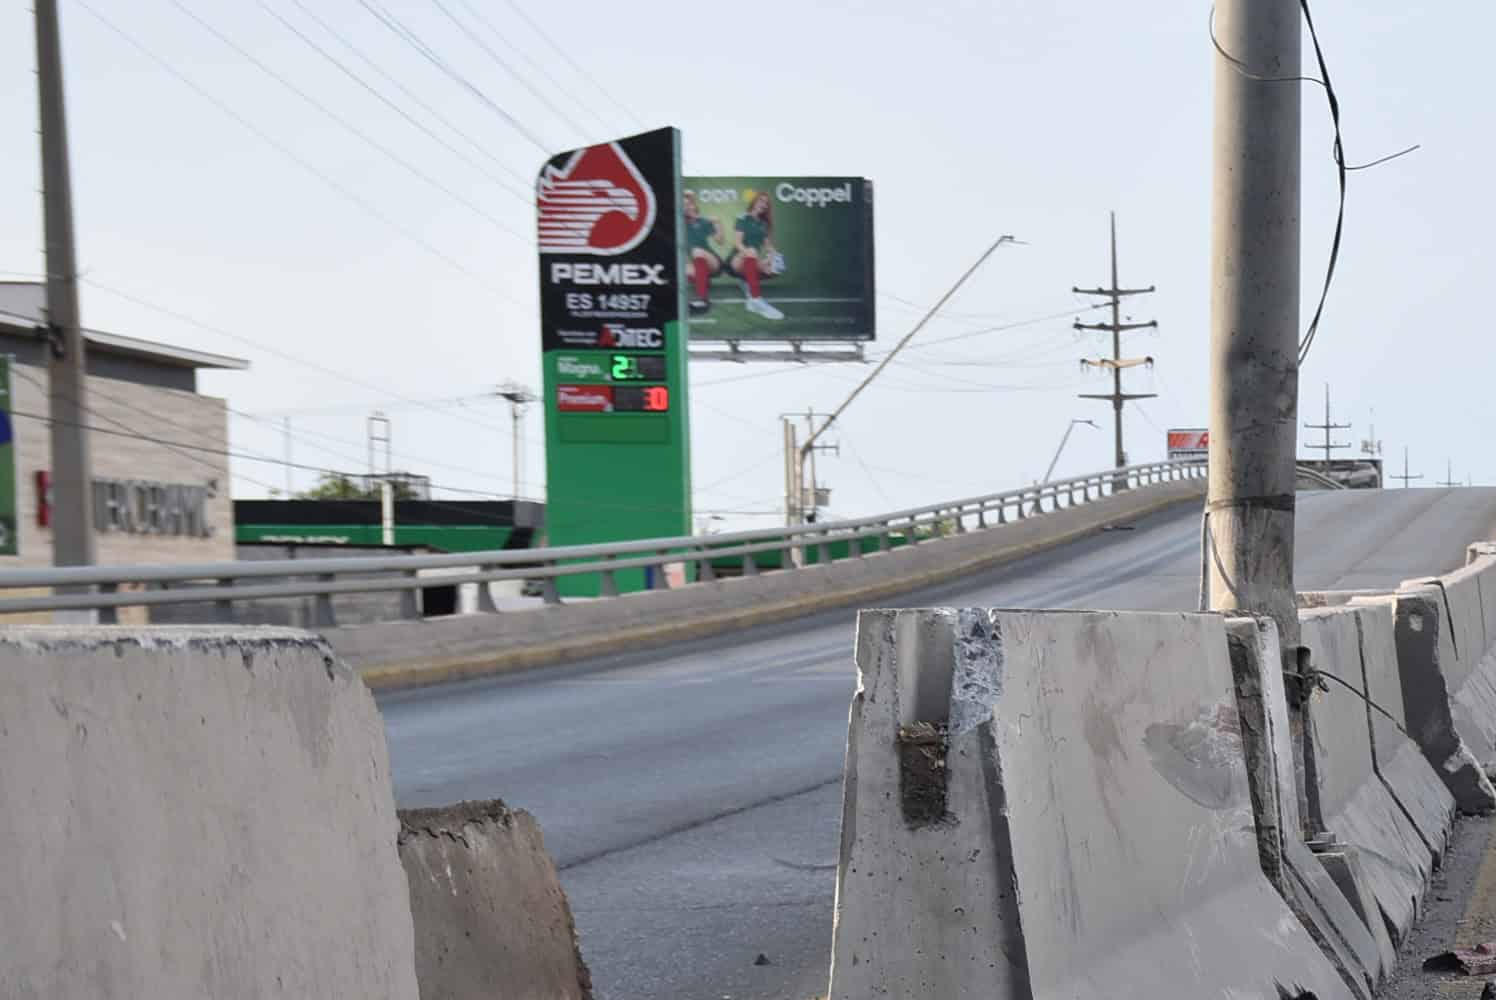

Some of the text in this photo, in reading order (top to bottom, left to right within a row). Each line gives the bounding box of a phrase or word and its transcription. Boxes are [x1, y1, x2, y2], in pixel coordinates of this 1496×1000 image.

[776, 183, 852, 208] Coppel
[551, 263, 666, 285] PEMEX
[565, 293, 593, 310] ES
